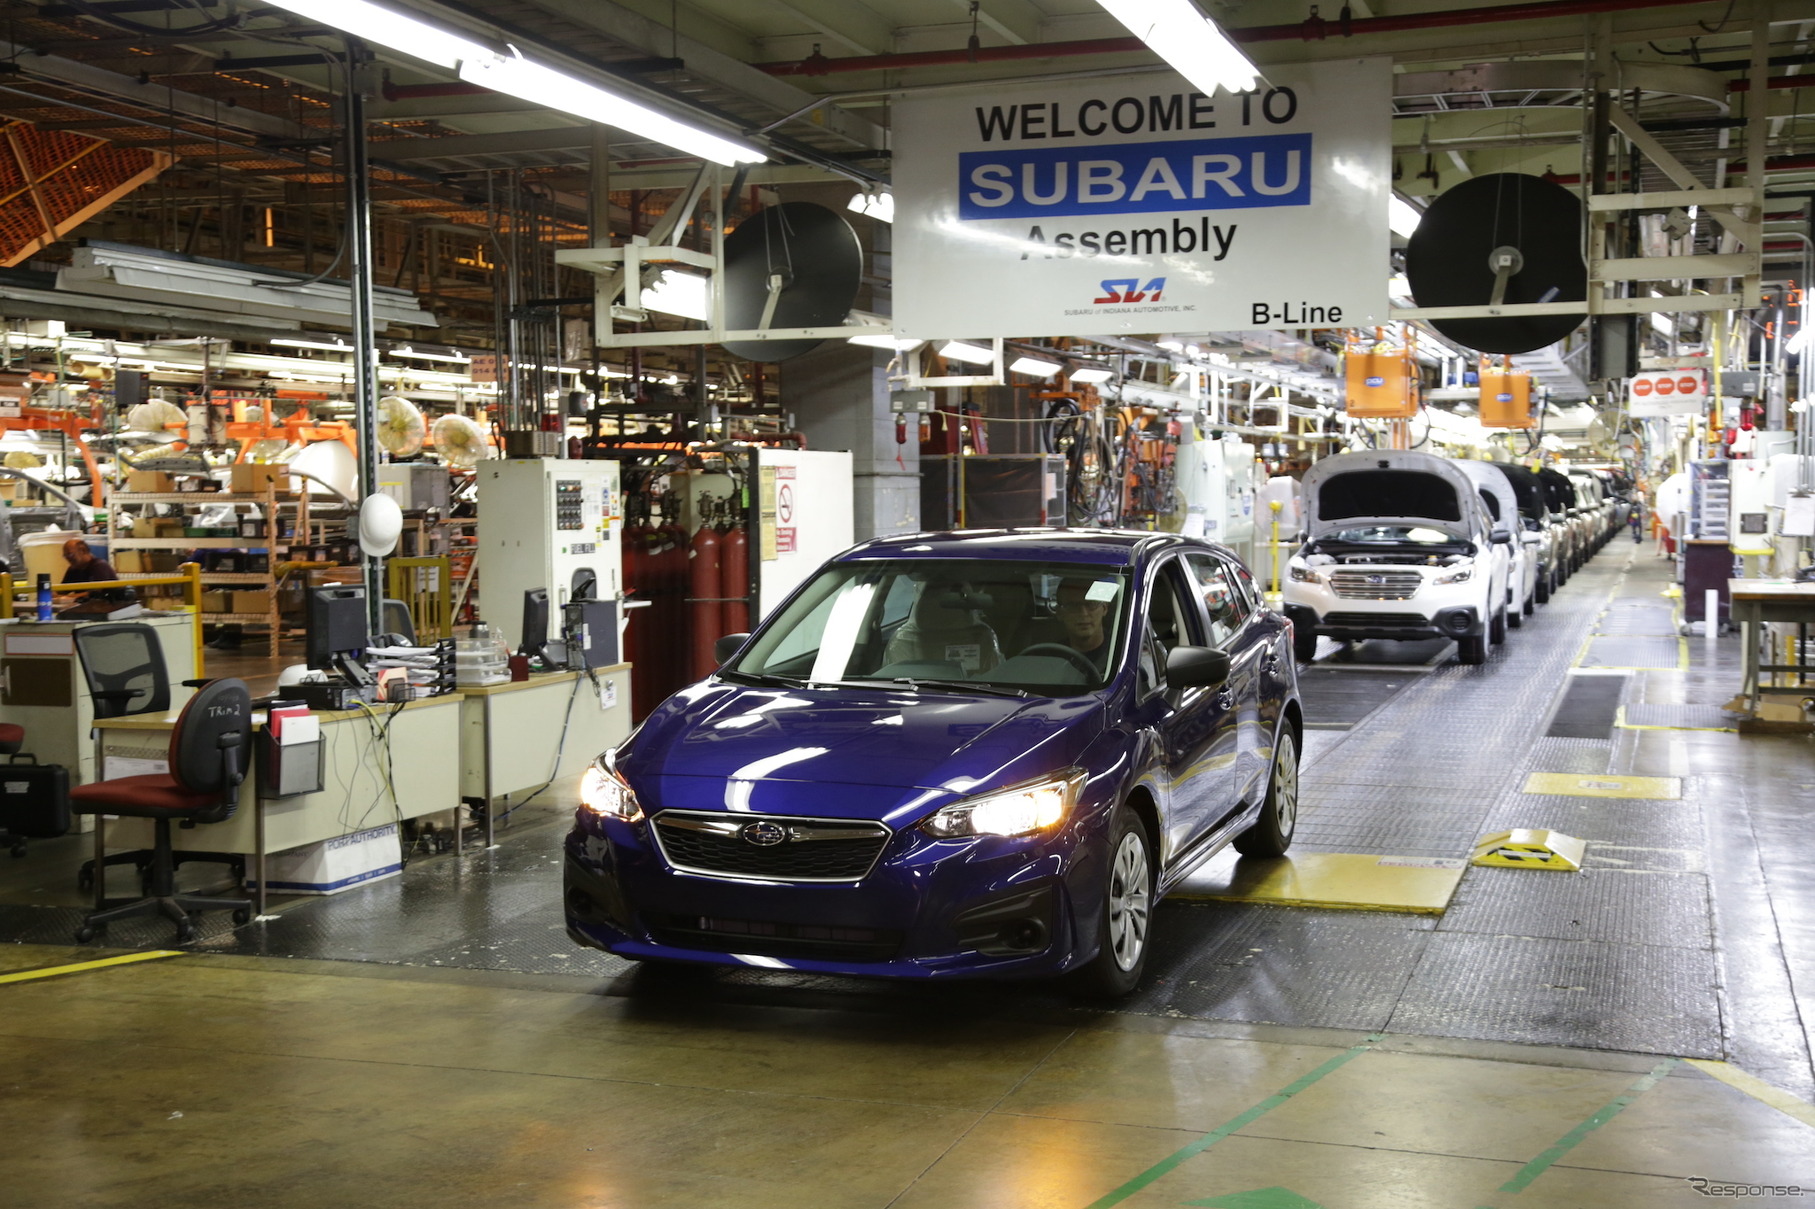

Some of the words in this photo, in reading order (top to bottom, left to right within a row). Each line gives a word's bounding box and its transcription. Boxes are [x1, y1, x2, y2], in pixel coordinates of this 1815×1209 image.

[976, 92, 1216, 142] WELCOME
[1233, 85, 1298, 126] TO
[968, 150, 1302, 208] SUBARU
[1020, 217, 1238, 261] Assembly
[1064, 308, 1094, 316] SUBARU
[1102, 307, 1131, 315] INDIANA
[1133, 304, 1181, 314] AUTOMOTIVE,
[1183, 304, 1197, 312] INC.
[1252, 301, 1343, 325] B-Line
[234, 703, 241, 716] 2
